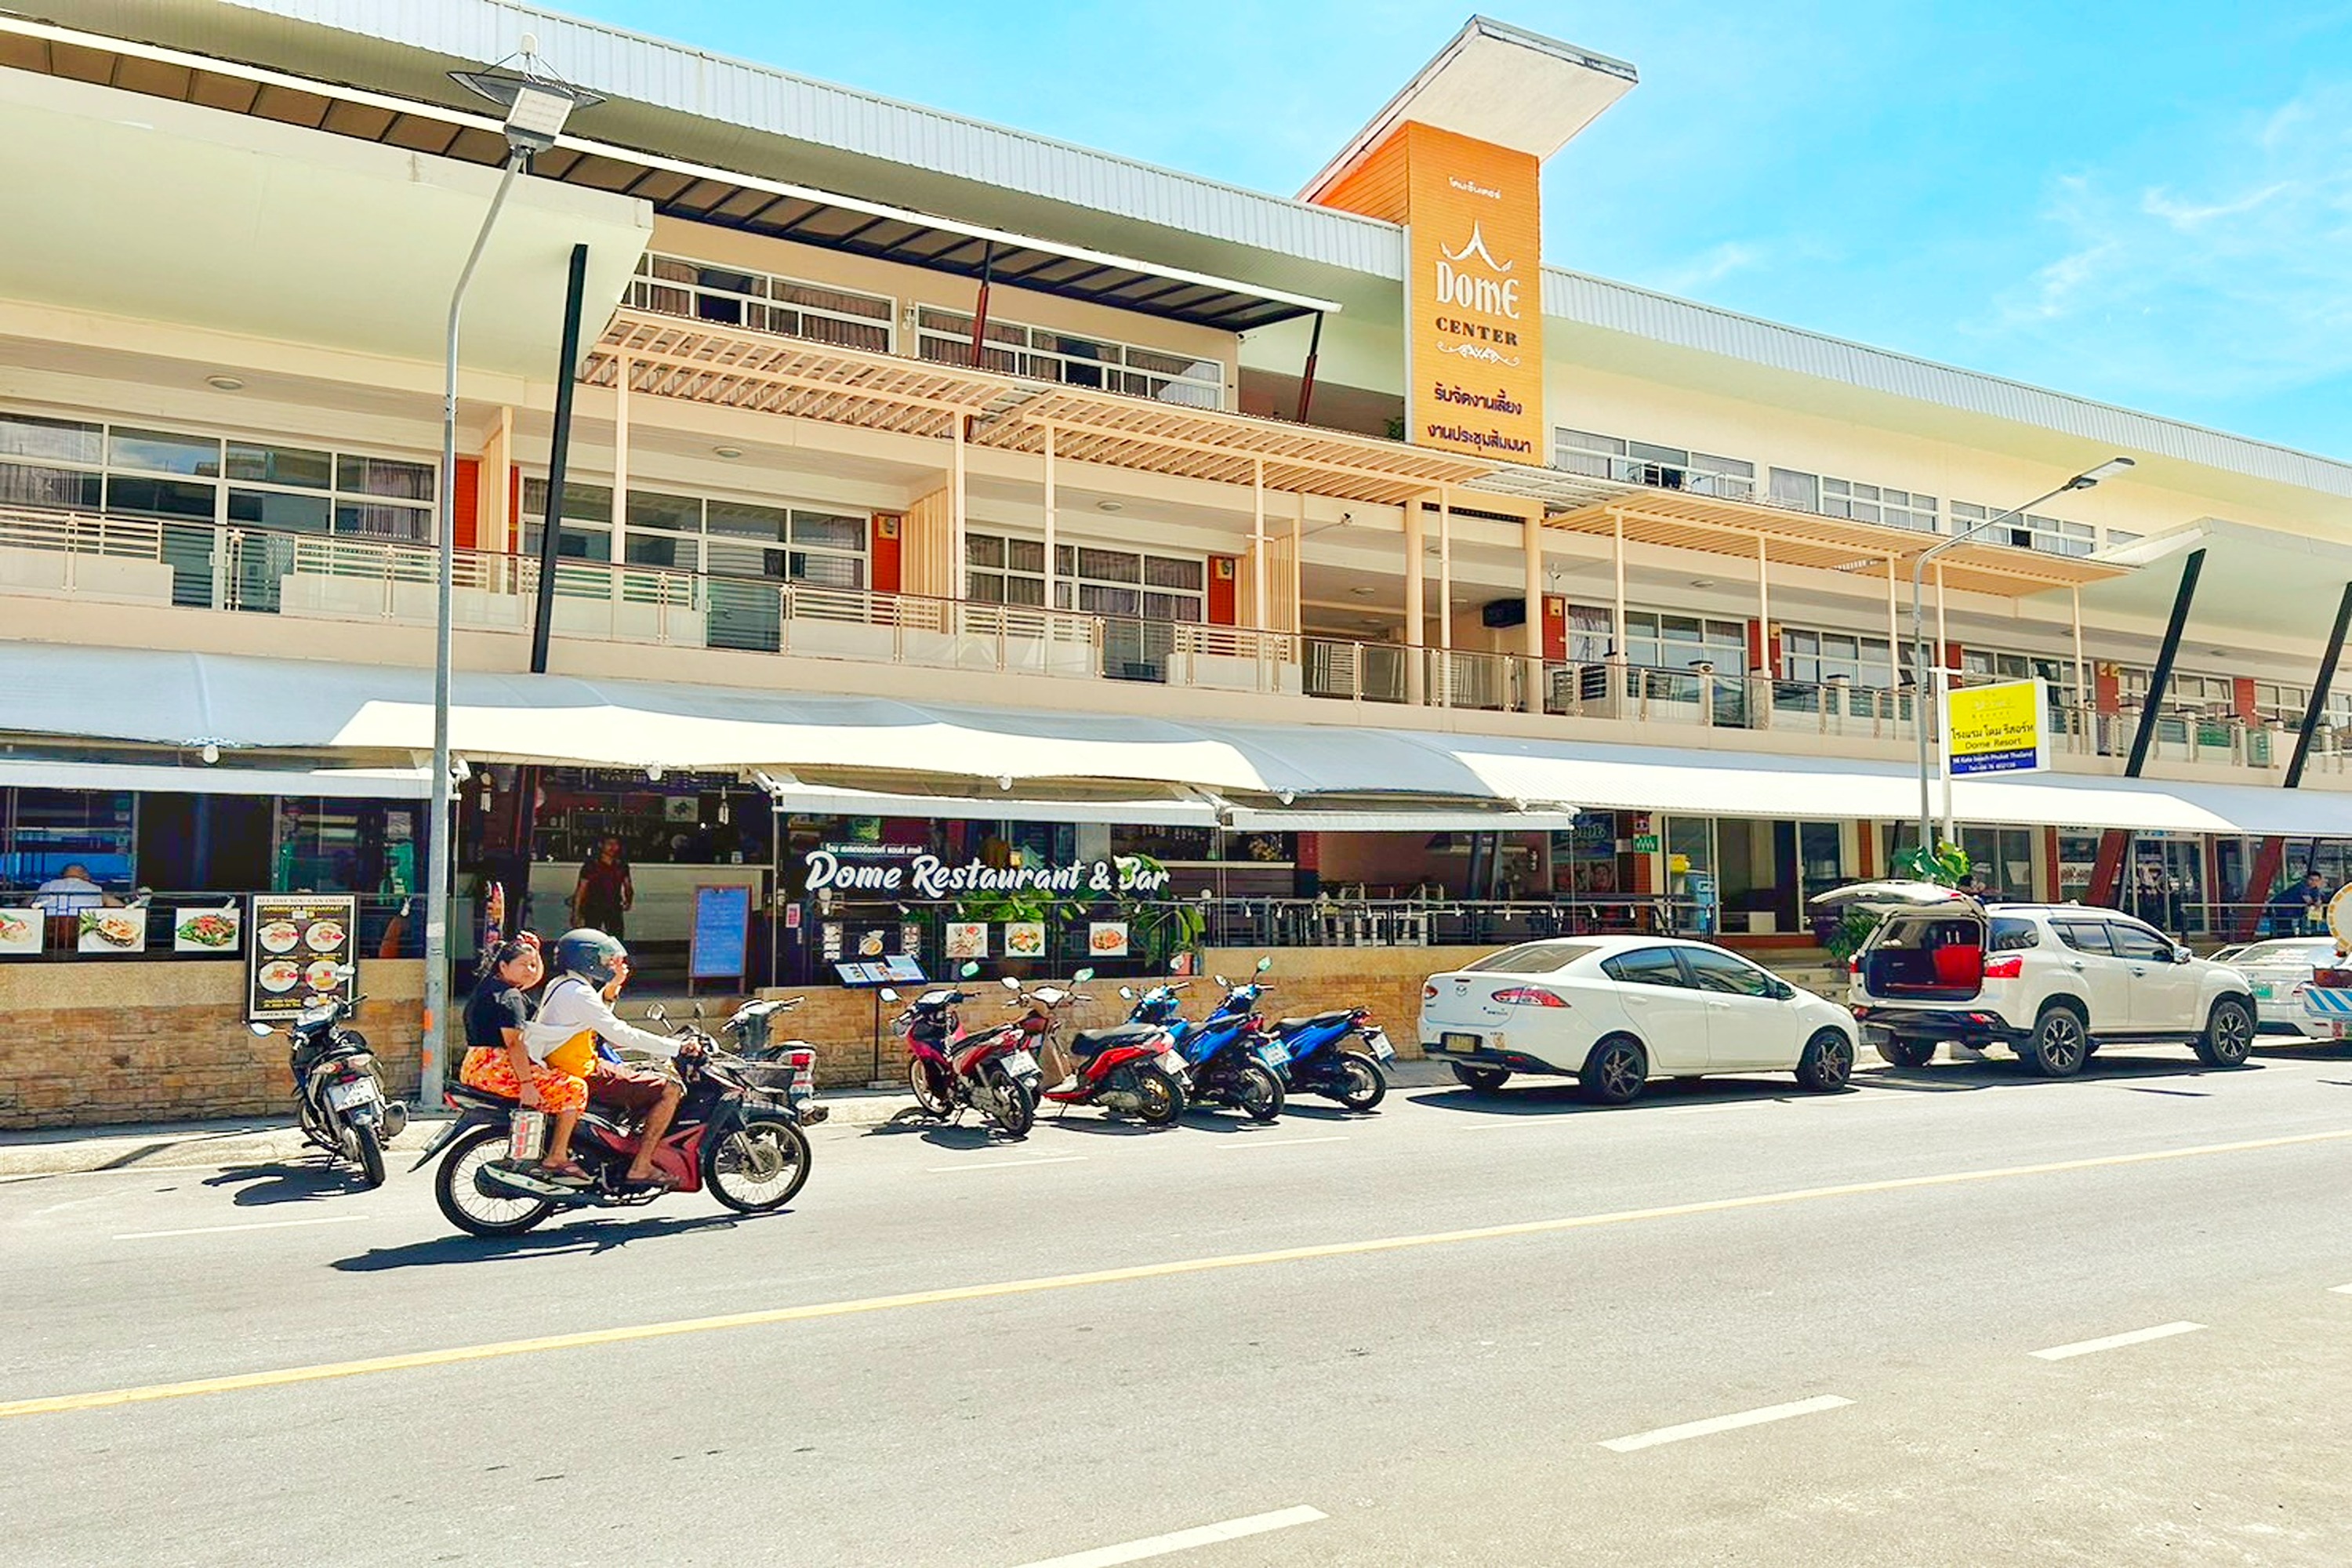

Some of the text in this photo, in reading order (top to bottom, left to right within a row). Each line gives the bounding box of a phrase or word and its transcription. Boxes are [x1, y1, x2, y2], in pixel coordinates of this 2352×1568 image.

[1436, 317, 1519, 347] CENTER
[1434, 381, 1523, 416] รับจัดงานเลี้ยง
[1427, 424, 1531, 454] งานประชุมสัมมนา
[1965, 738, 2022, 750] Dome Resort
[805, 850, 902, 891] Dome
[912, 855, 1086, 899] Restaurant
[1089, 861, 1112, 891] &
